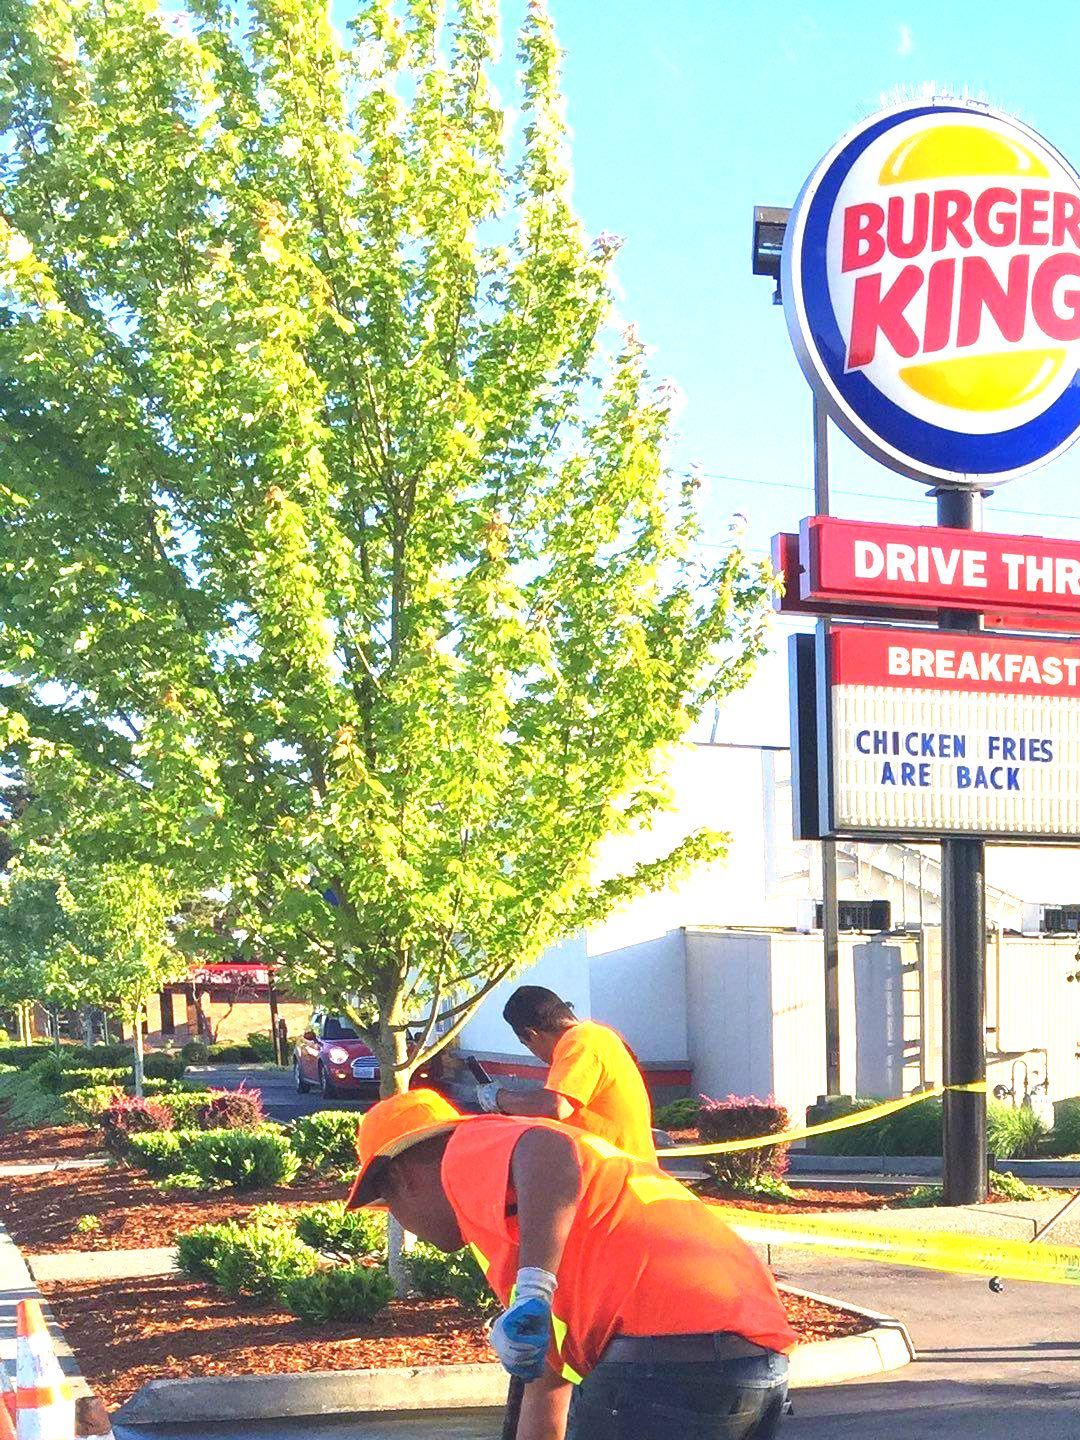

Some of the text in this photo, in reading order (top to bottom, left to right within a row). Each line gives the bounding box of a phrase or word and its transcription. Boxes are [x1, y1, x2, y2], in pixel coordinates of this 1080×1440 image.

[853, 541, 987, 587] DRIVE
[887, 647, 1080, 686] BREAKFAST
[856, 730, 1054, 763] CHICKEN FRIES
[881, 761, 1020, 791] ARE BACK
